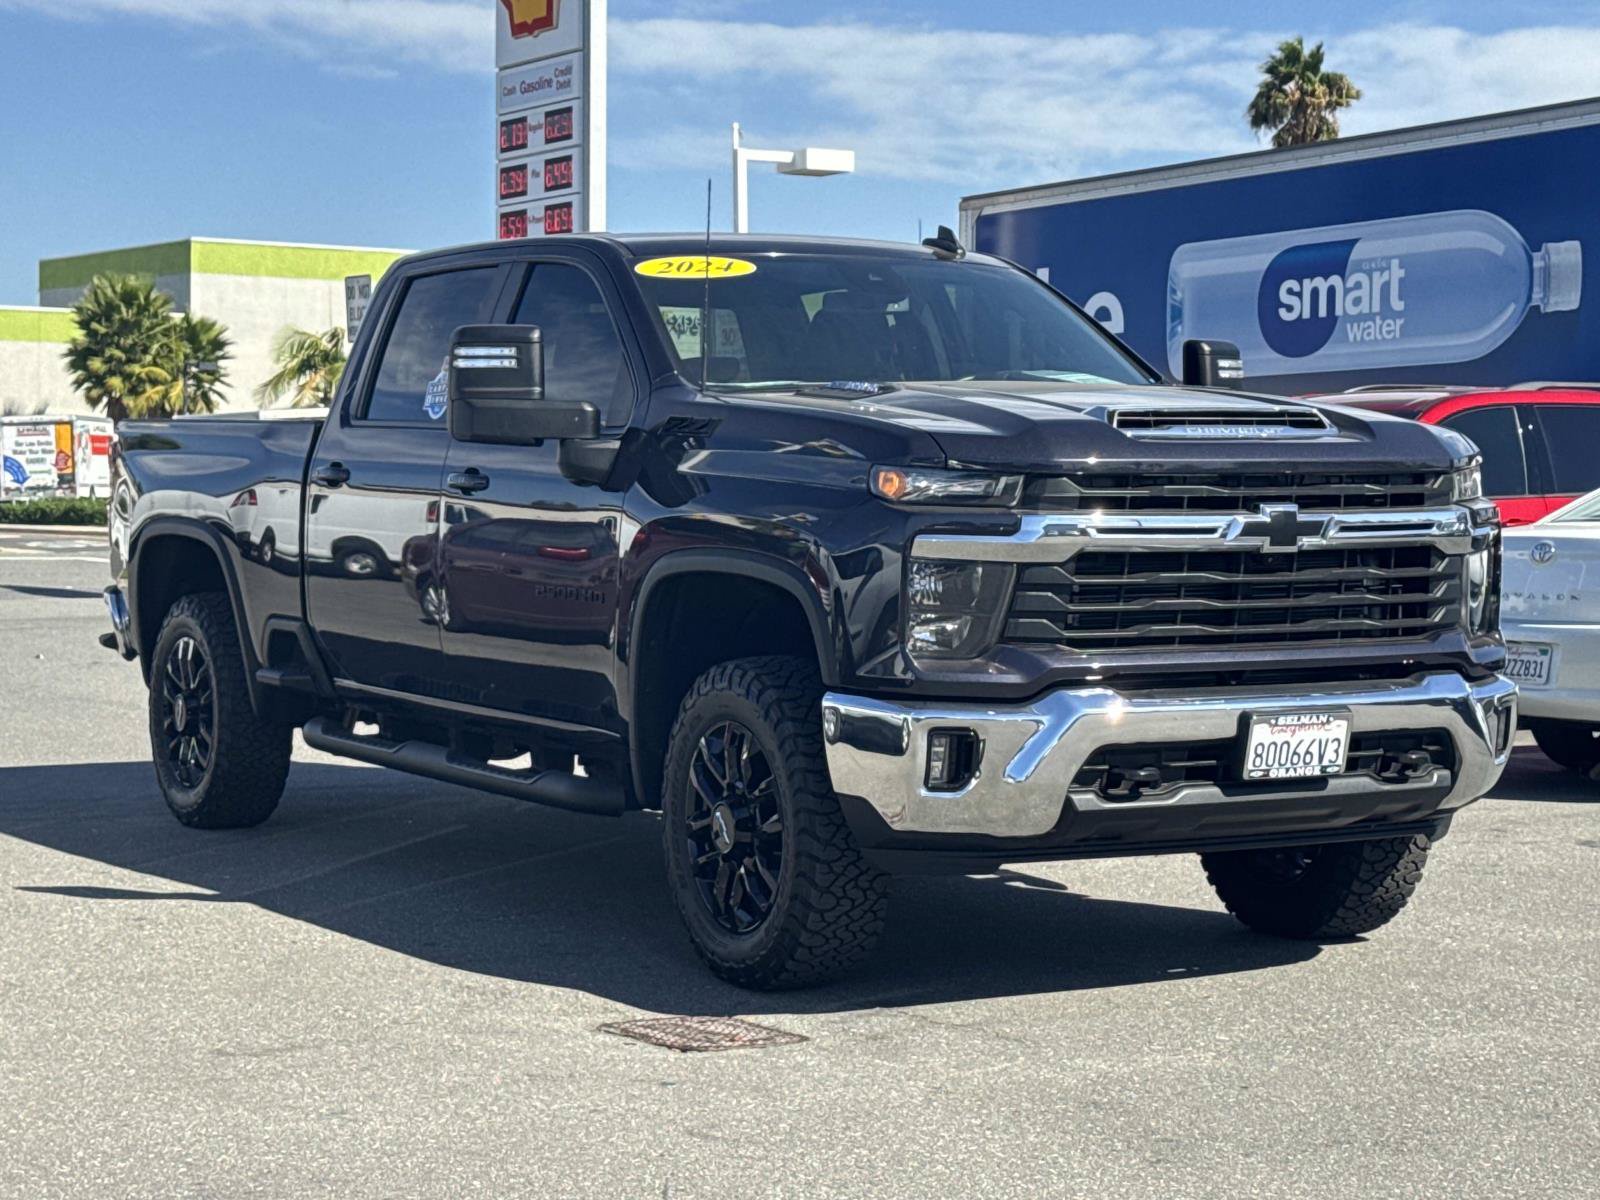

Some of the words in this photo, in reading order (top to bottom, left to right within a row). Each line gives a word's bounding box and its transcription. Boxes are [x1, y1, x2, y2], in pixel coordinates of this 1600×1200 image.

[520, 76, 554, 95] Gasoline
[657, 261, 734, 274] 2024
[1278, 258, 1406, 322] smart
[1346, 315, 1406, 343] water
[1277, 714, 1328, 725] SELMAN
[1252, 738, 1341, 768] 80066V3
[1269, 766, 1321, 778] ORANGE
